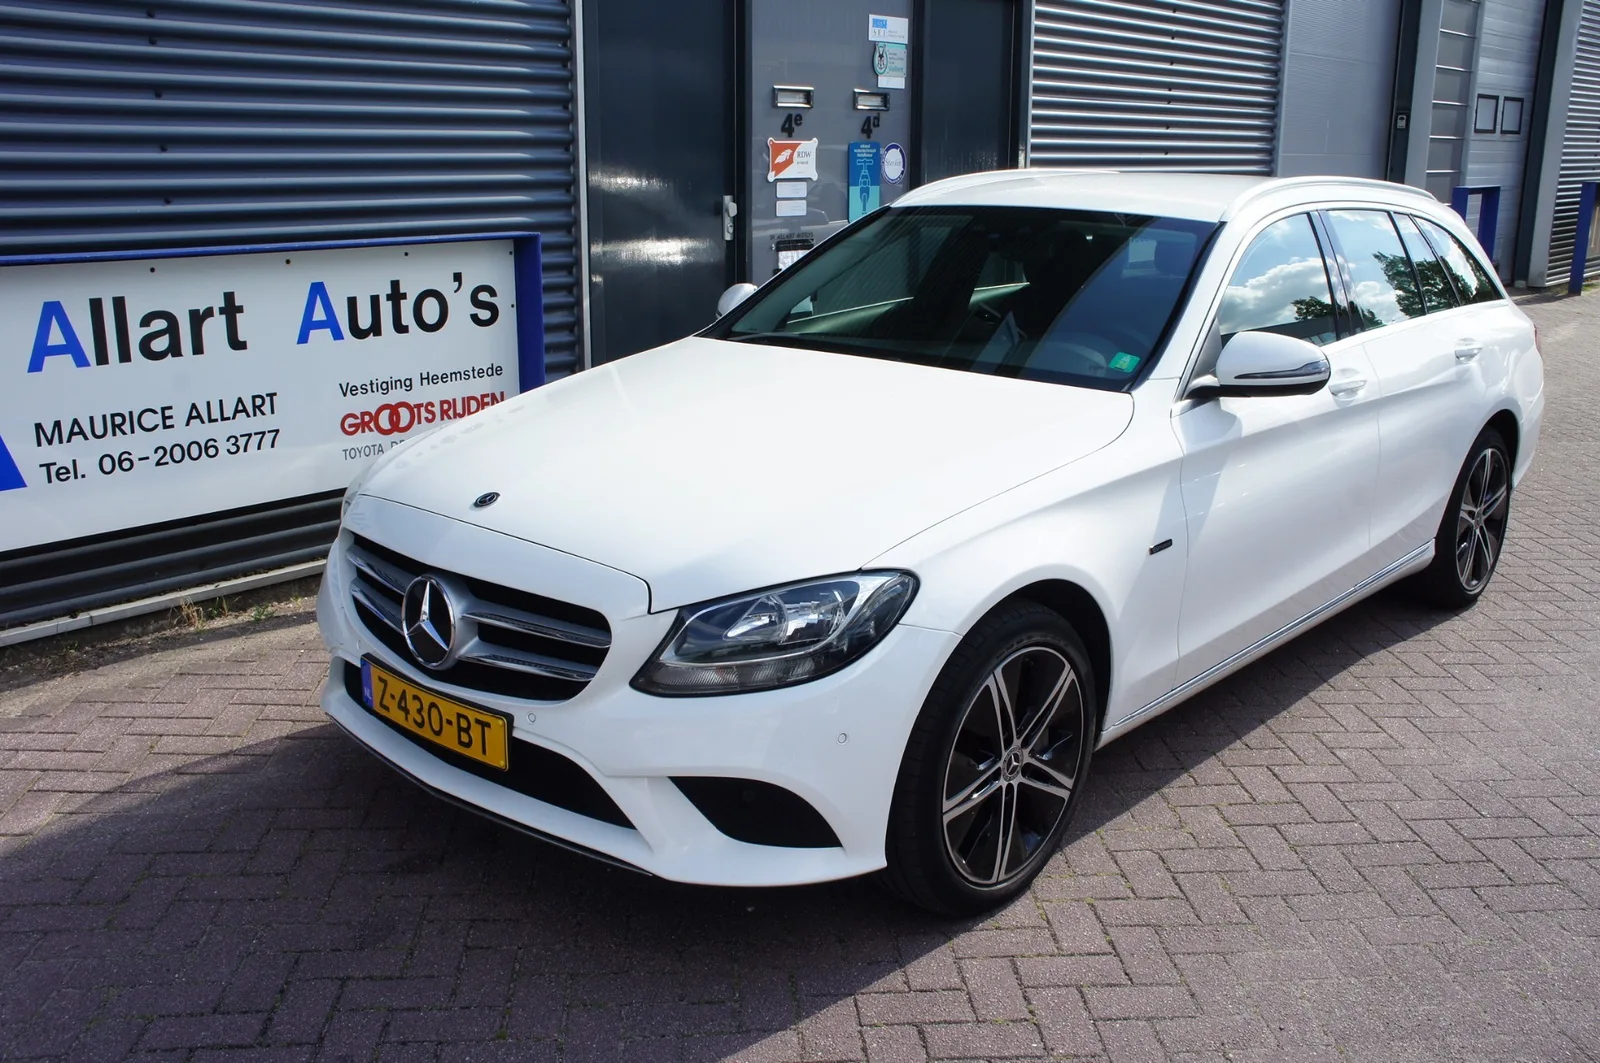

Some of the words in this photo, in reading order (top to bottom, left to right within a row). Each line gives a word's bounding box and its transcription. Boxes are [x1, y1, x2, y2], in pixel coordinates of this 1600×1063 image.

[781, 113, 803, 138] 4e
[861, 112, 880, 139] 4d
[797, 150, 812, 158] RDW
[27, 291, 248, 373] Allart
[296, 272, 500, 345] Auto's
[339, 377, 413, 398] Vestiging
[420, 363, 503, 387] Heemstede
[34, 404, 175, 448] MAURICE
[185, 392, 278, 427] ALLART
[340, 401, 437, 436] GROOTS
[39, 458, 87, 485] Tel.
[98, 438, 219, 475] 06-2006
[225, 428, 280, 456] 3777
[342, 443, 385, 460] TOYOTA
[377, 675, 492, 756] Z-430-BT
